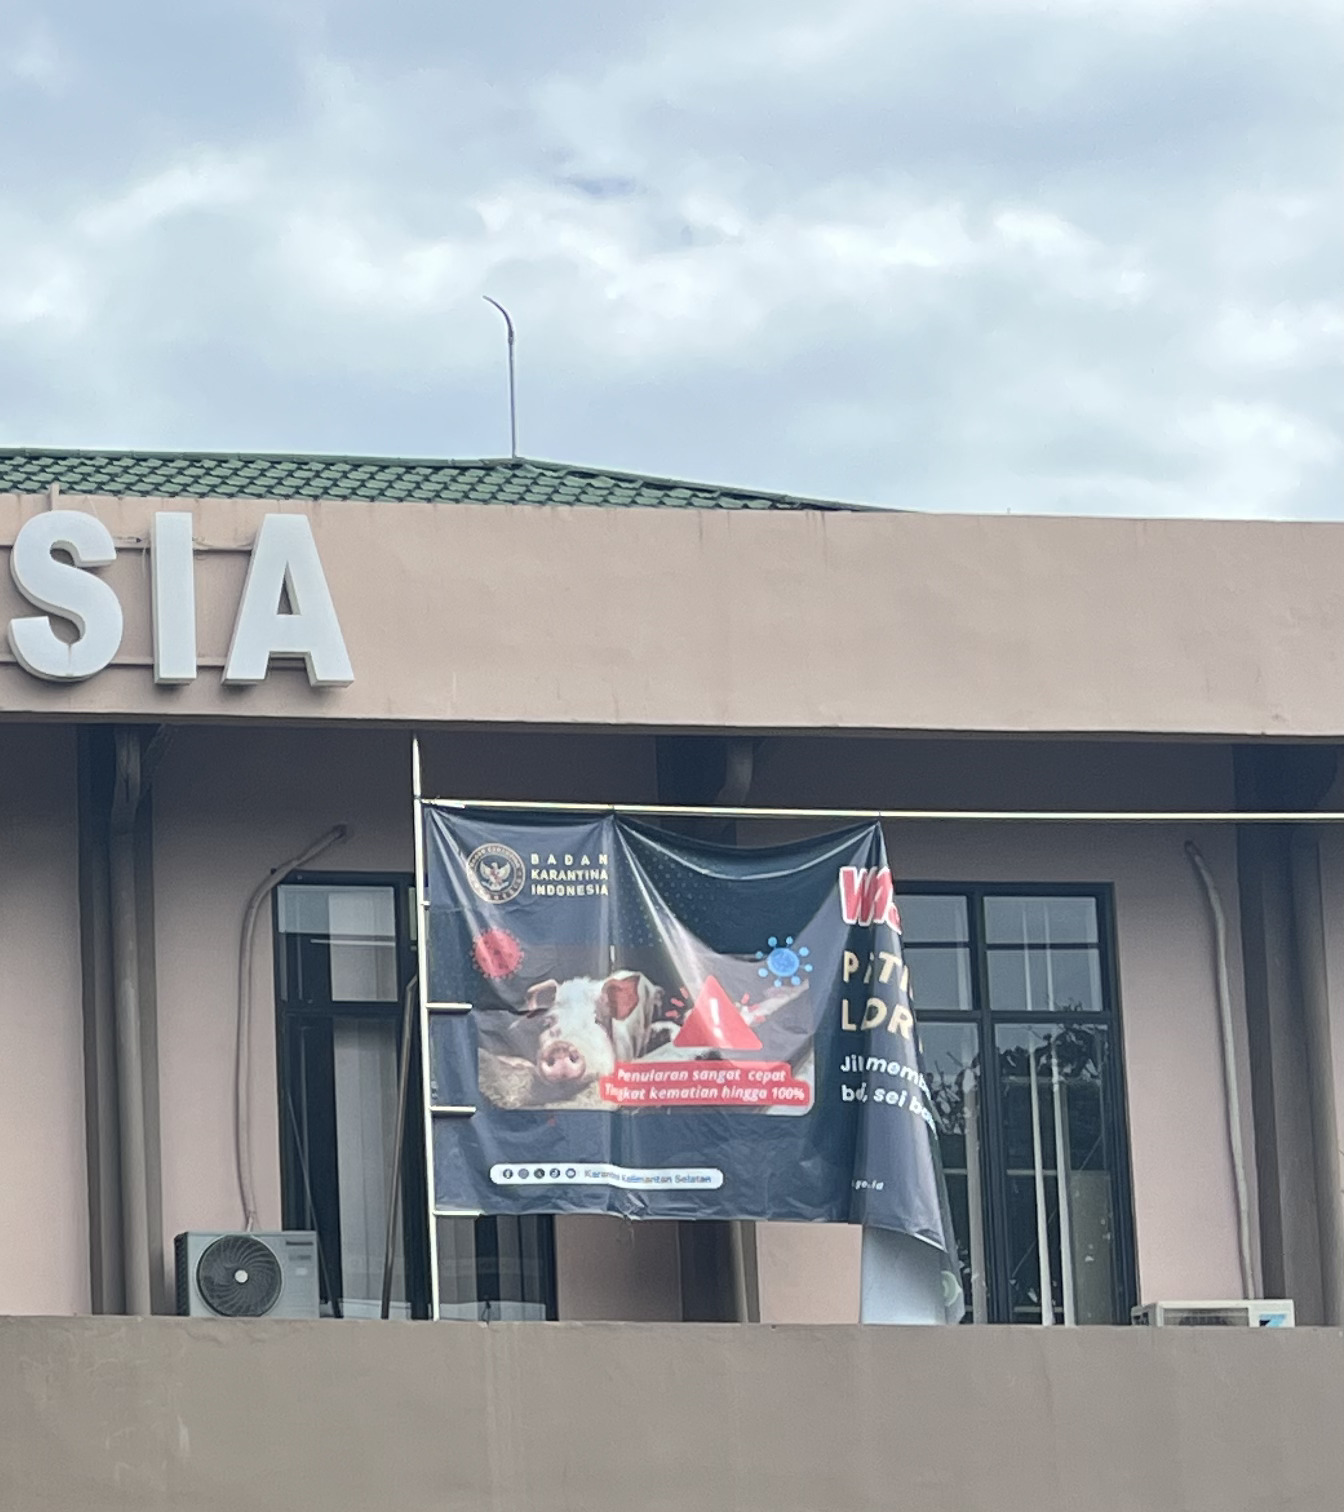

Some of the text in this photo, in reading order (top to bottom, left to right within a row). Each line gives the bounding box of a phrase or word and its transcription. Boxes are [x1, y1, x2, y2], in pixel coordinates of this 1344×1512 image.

[530, 853, 608, 866] BADAN
[531, 869, 609, 881] KARANTINA
[531, 884, 609, 896] INDONESIA
[618, 1068, 786, 1084] Penularan sangat cepat
[649, 1085, 717, 1100] kematian
[721, 1085, 767, 1101] hingga
[771, 1087, 805, 1100] 100%
